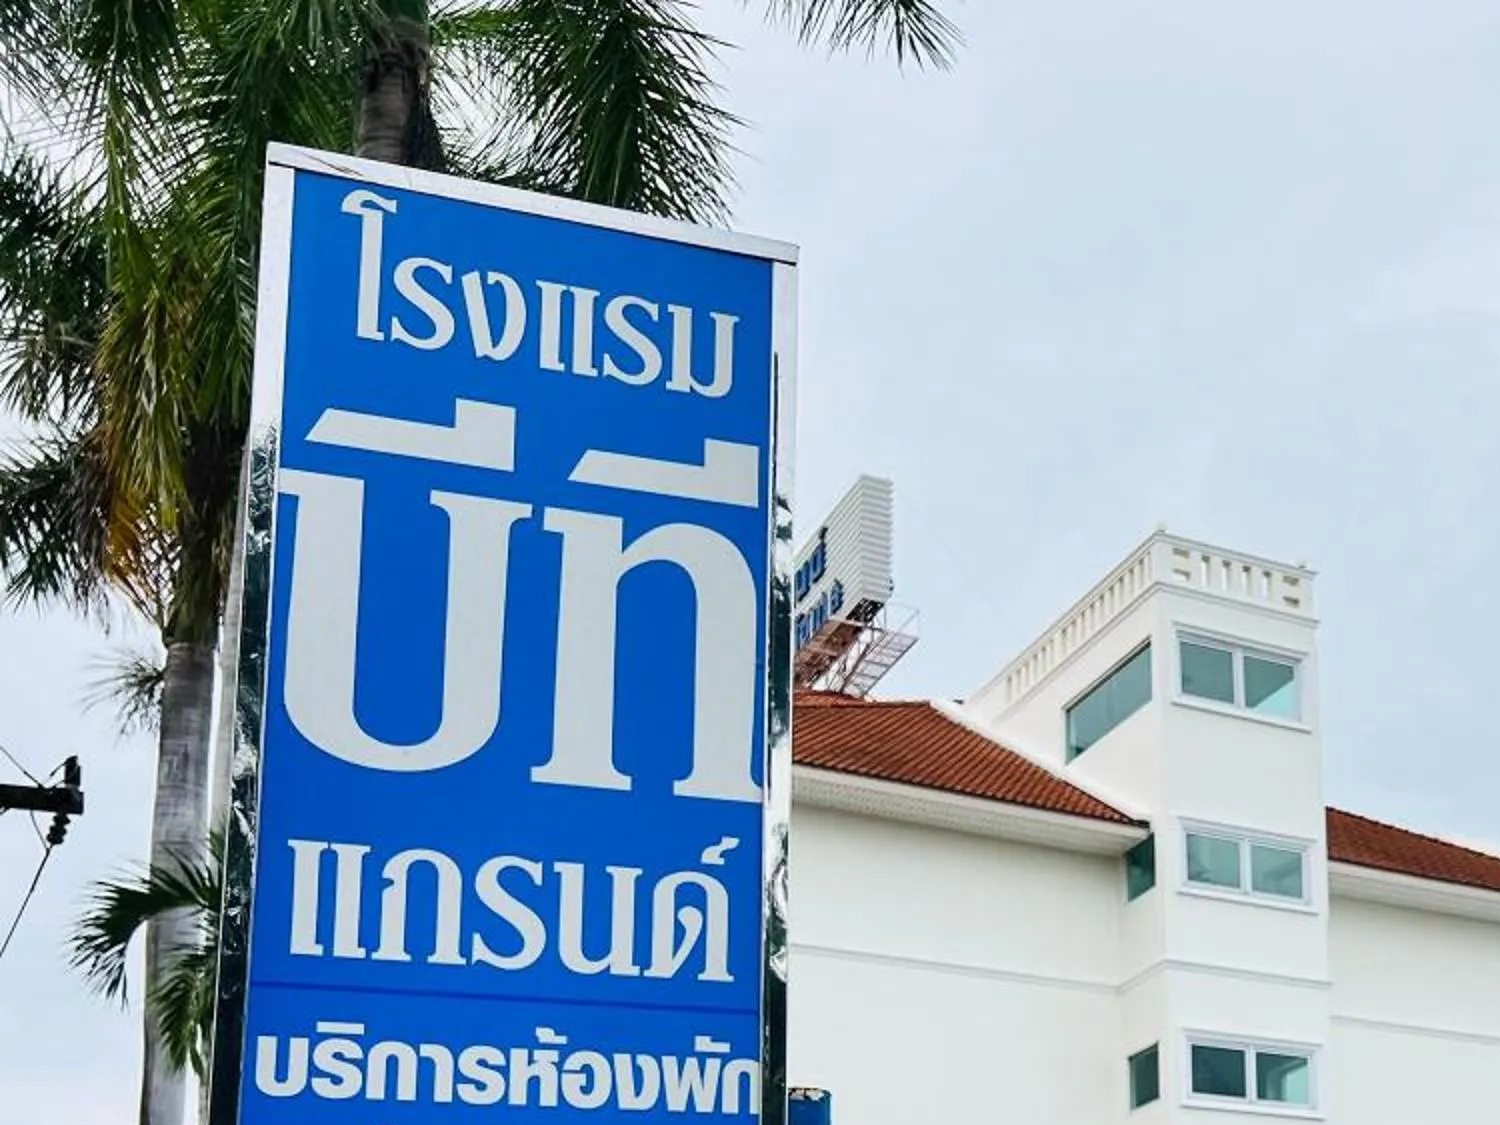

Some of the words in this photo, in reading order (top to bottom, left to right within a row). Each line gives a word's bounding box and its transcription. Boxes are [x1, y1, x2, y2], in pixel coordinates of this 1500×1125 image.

[341, 190, 739, 398] โรงแรม
[277, 398, 762, 803] บีที
[288, 836, 739, 981] แกรนด์
[255, 1021, 760, 1115] บริการห้องพัก
